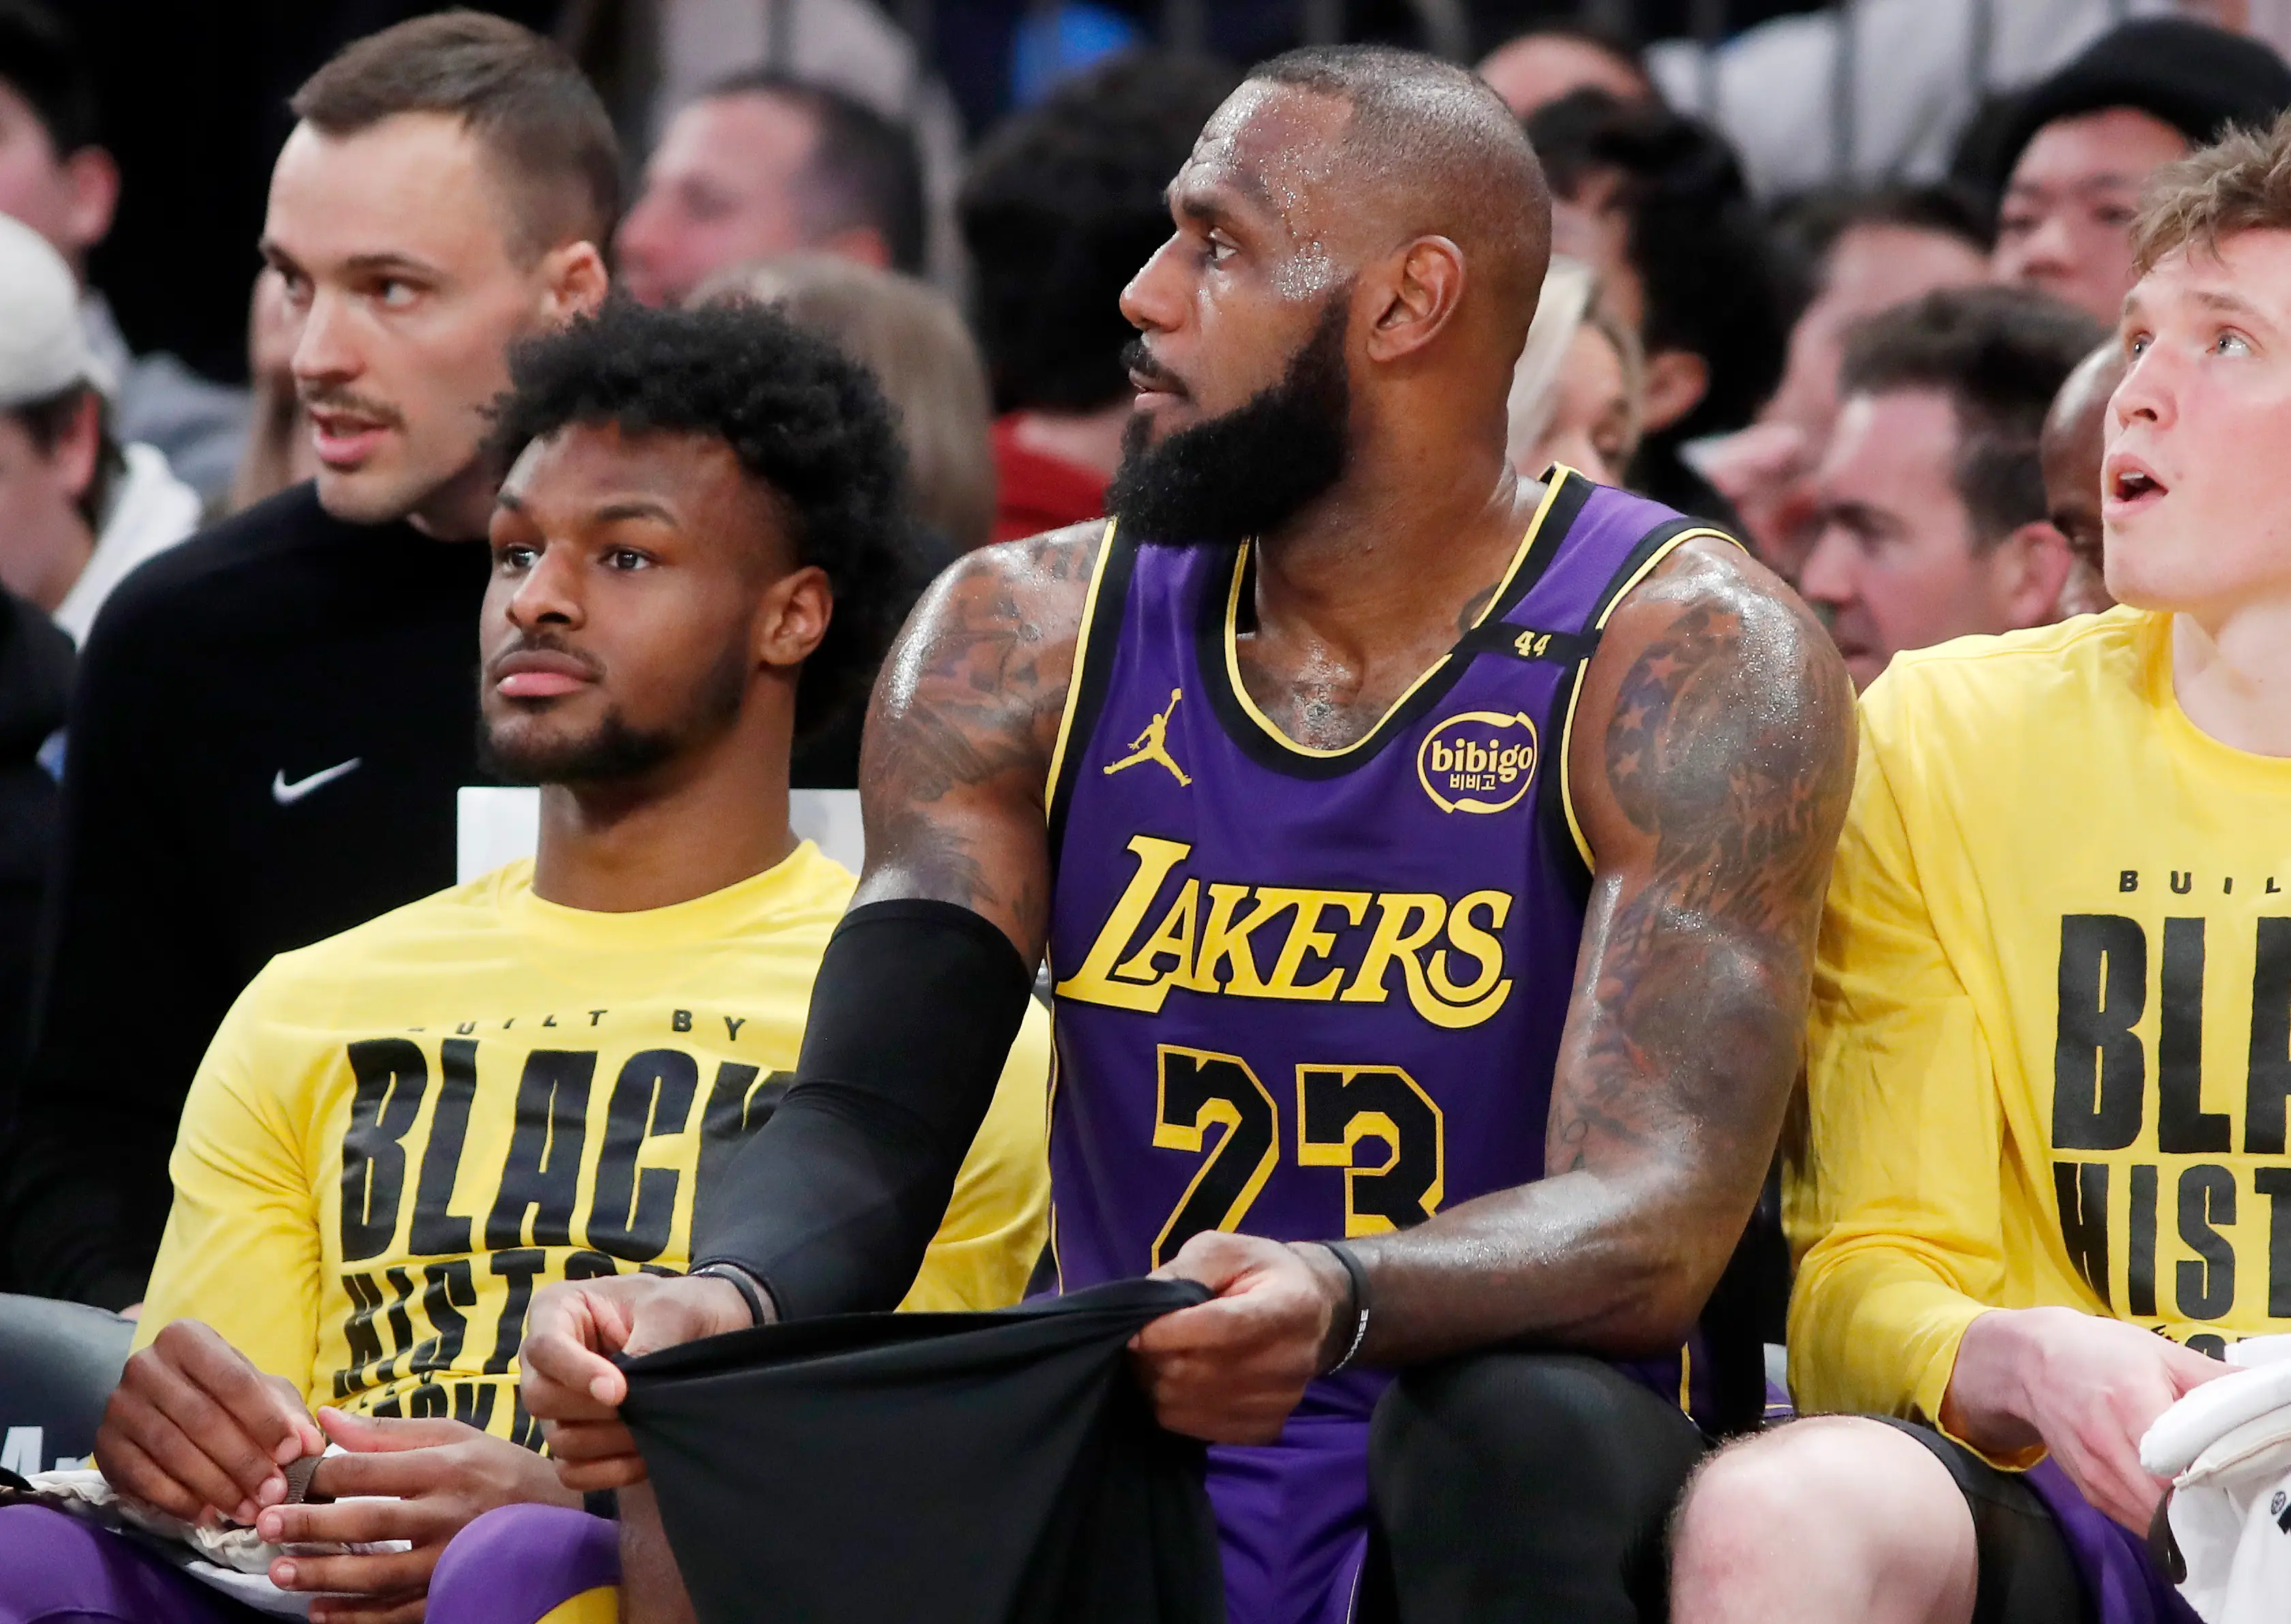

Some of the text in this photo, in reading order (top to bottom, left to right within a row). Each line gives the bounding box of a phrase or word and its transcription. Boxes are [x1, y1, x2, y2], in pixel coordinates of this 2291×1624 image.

[1514, 630, 1552, 657] 44
[1432, 737, 1533, 783] bibigo
[1449, 773, 1496, 791] 비비고
[1055, 835, 1513, 1029] LAKERS
[408, 1009, 746, 1041] UILT BY
[1152, 1043, 1444, 1272] 23
